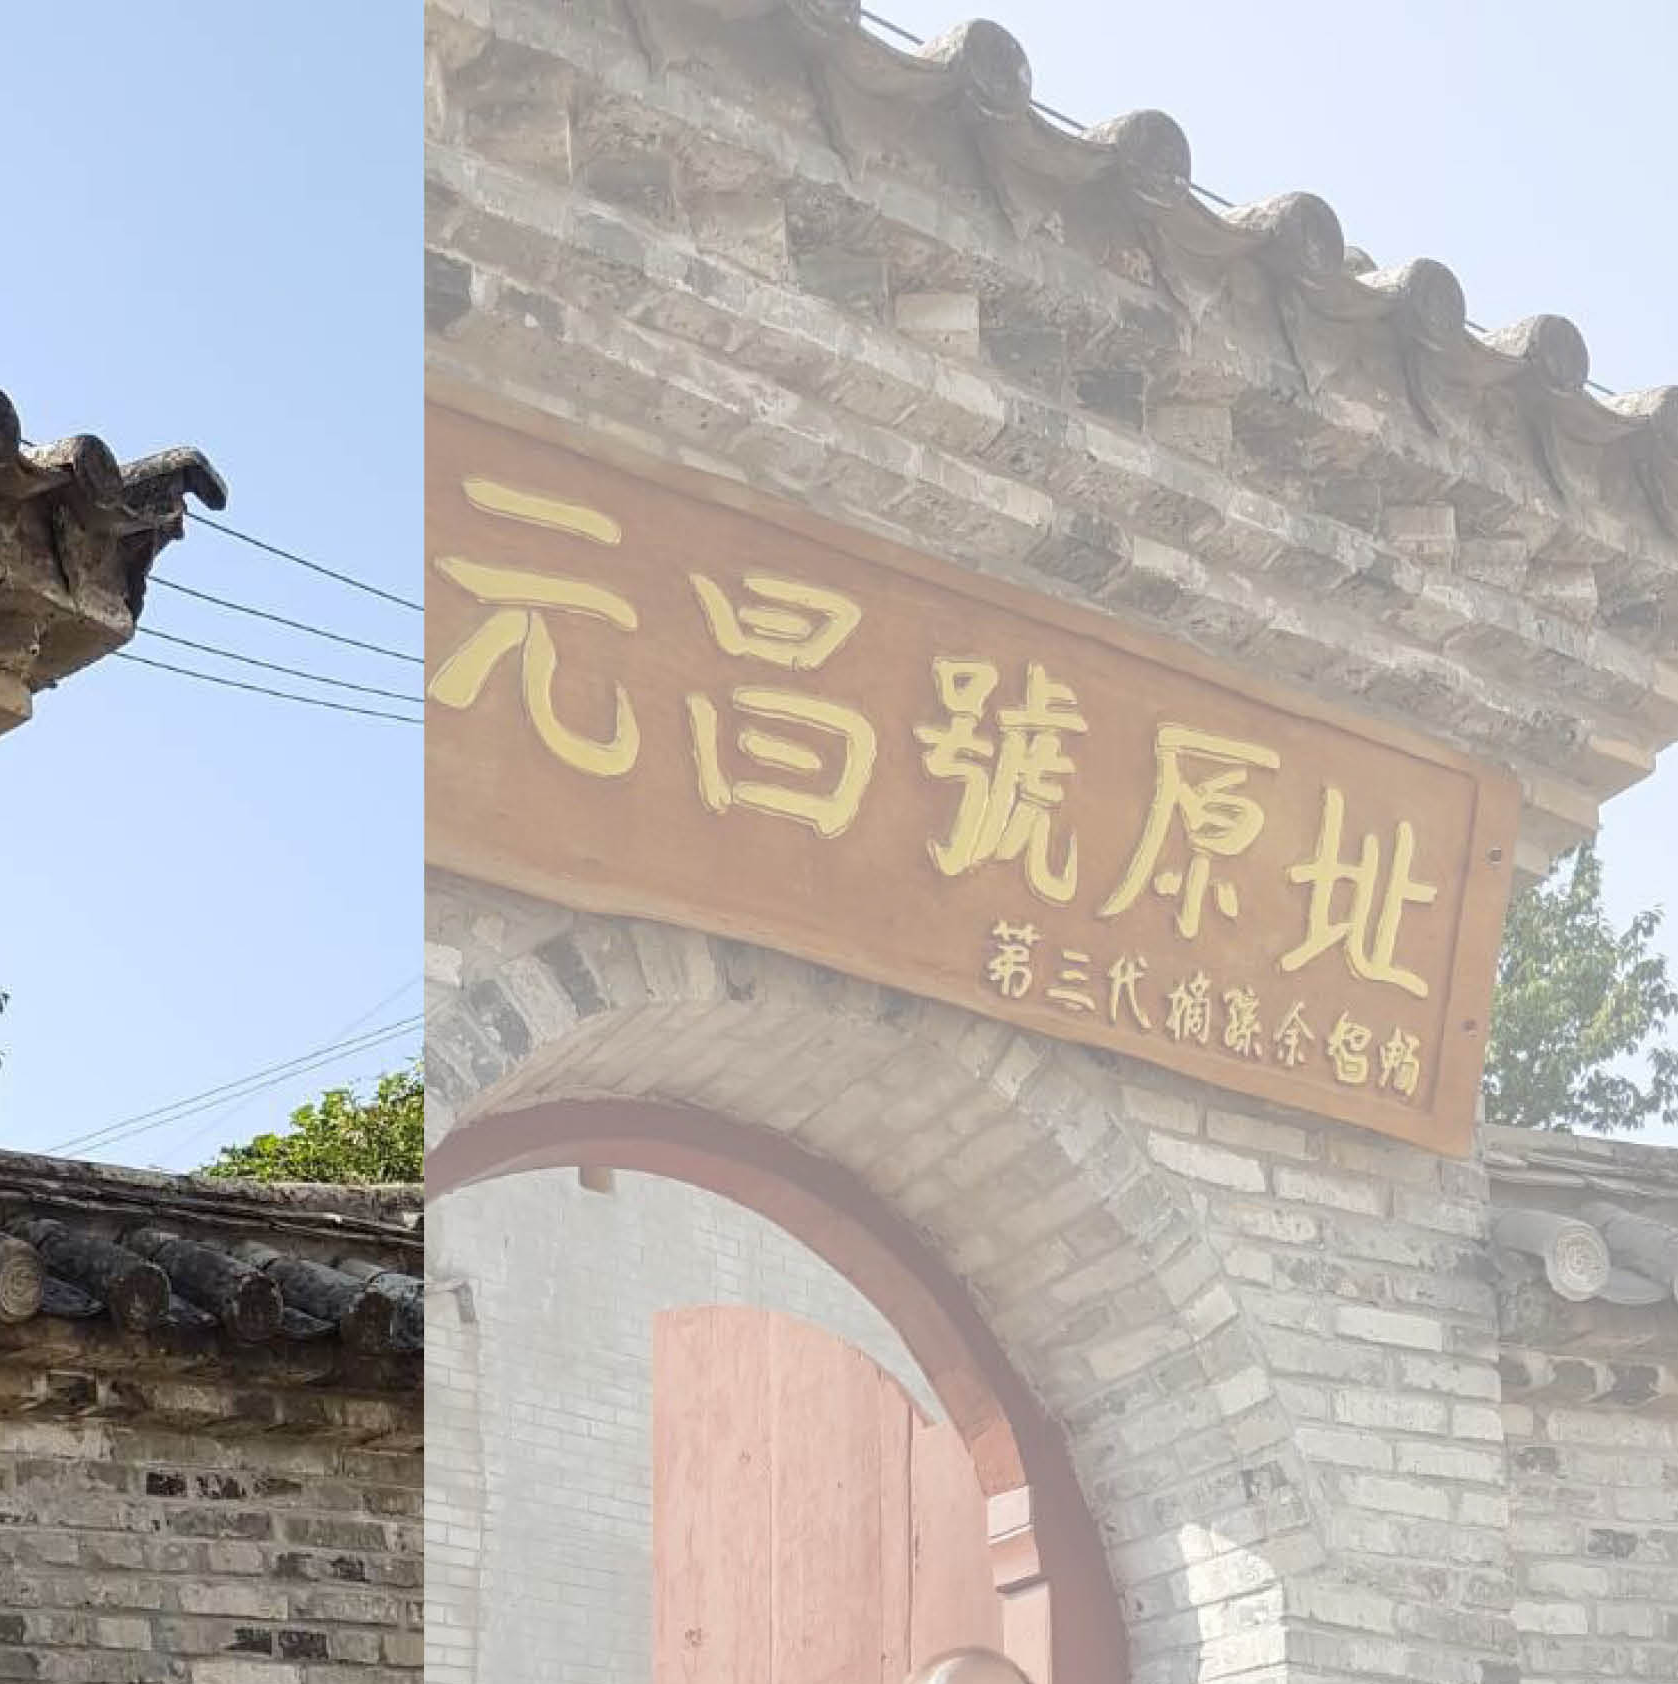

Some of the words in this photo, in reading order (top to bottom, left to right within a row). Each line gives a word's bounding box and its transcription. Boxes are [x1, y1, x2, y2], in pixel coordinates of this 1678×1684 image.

[428, 476, 1438, 999] 元昌號原址
